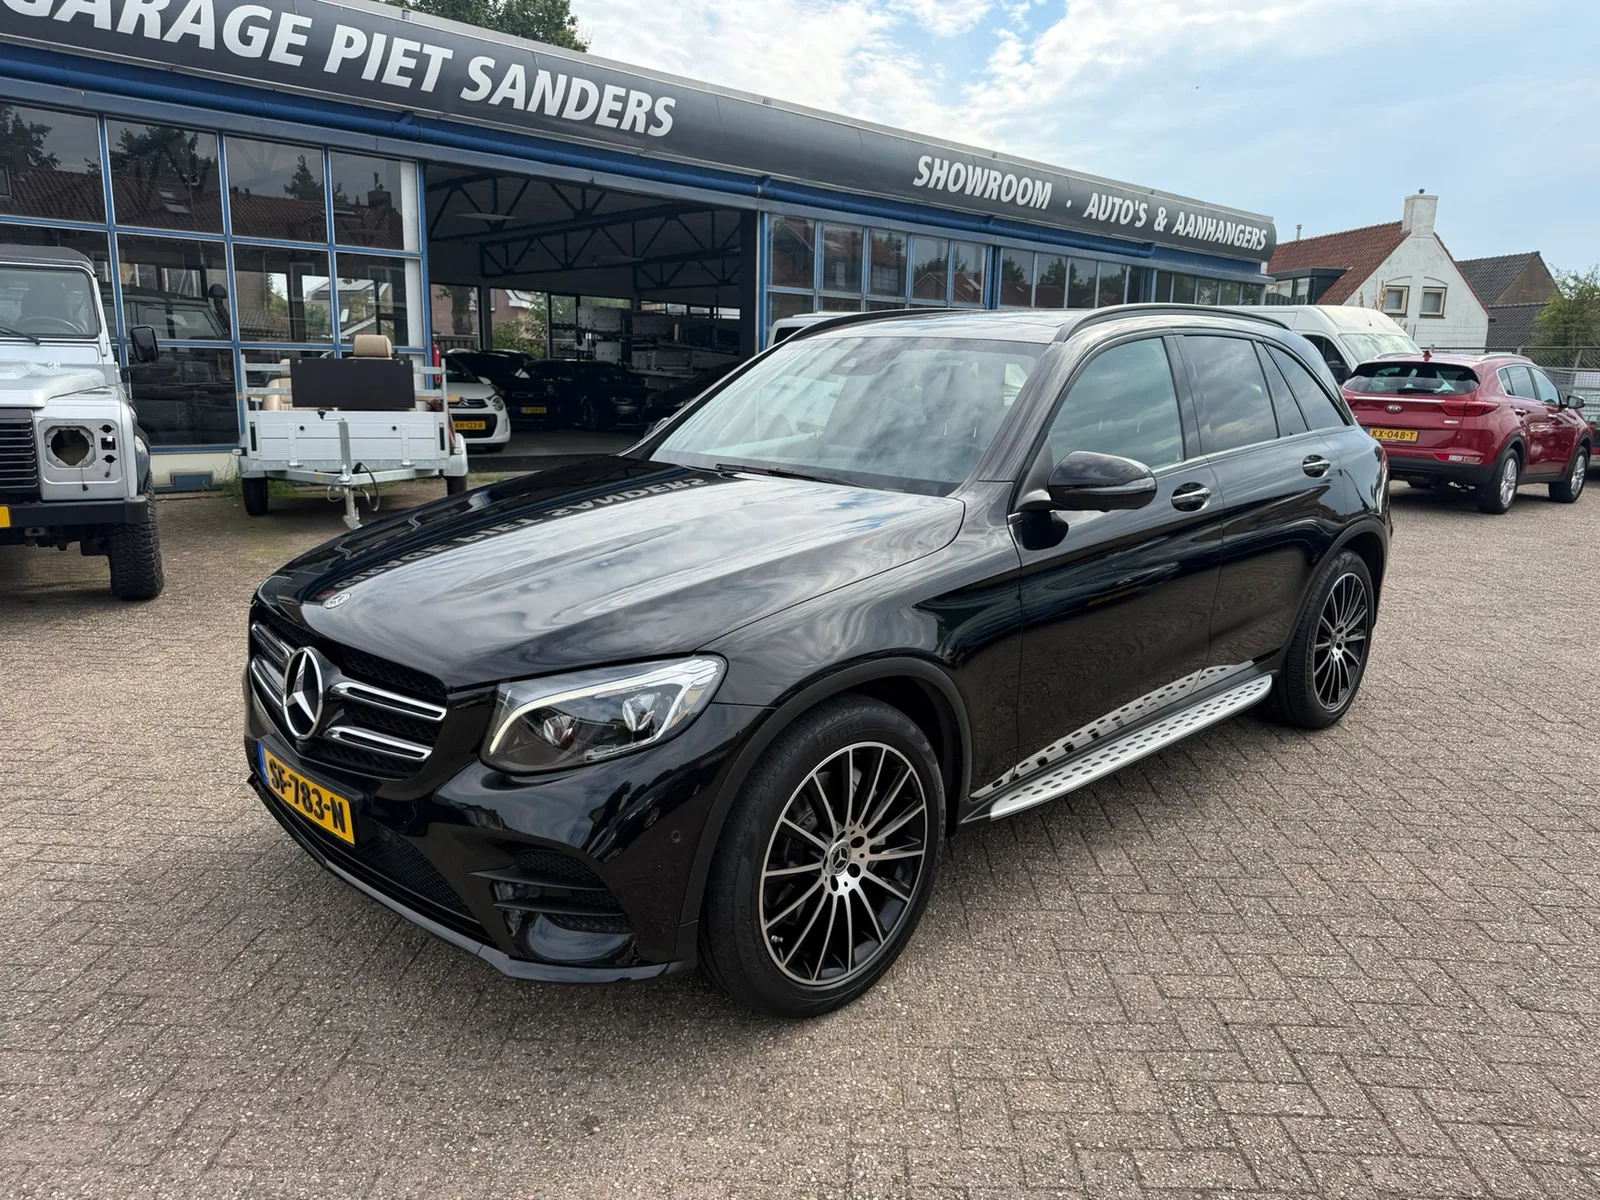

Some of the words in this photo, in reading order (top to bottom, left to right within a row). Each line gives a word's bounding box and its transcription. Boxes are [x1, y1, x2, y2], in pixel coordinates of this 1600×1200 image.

[1, 0, 313, 67] ARAGE
[323, 26, 454, 93] PIET
[459, 56, 677, 138] SANDERS
[912, 154, 1053, 210] SHOWROOM
[1082, 191, 1148, 229] AUTO'S
[1153, 206, 1168, 232] &
[1171, 211, 1268, 251] AANHANGERS
[1371, 429, 1416, 440] KX-048-T
[268, 758, 347, 834] SF-783-N
